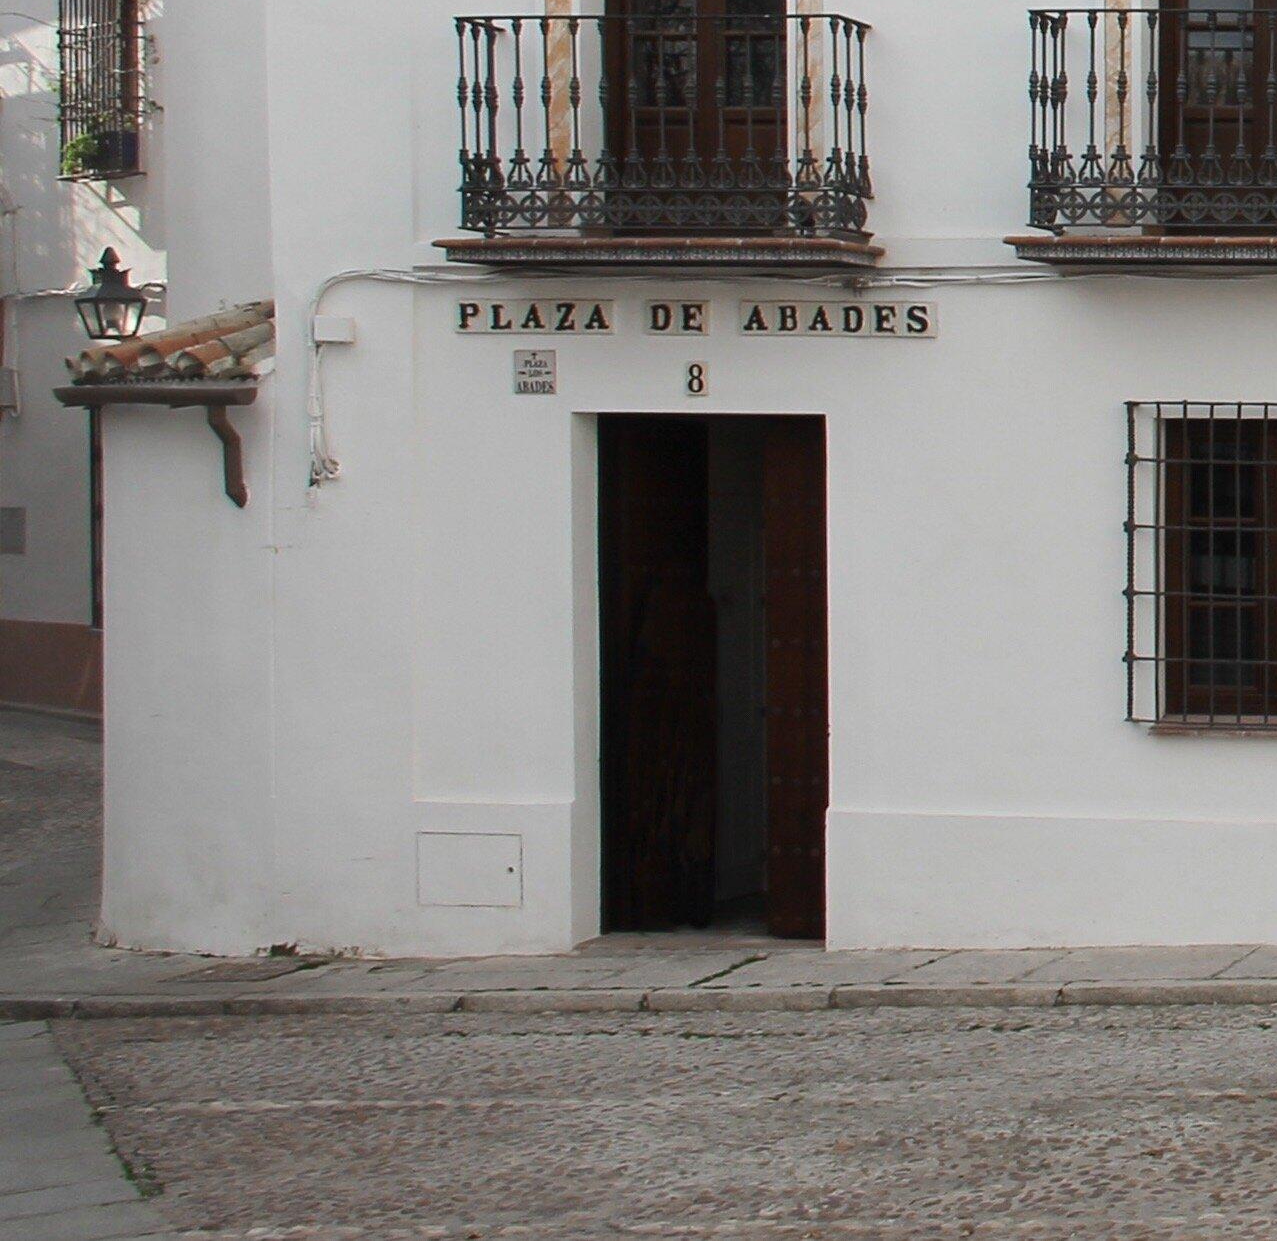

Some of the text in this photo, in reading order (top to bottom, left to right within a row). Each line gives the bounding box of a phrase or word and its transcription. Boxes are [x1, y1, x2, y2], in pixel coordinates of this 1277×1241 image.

[458, 302, 930, 335] PLAZA DE ABADES
[687, 363, 704, 394] 8
